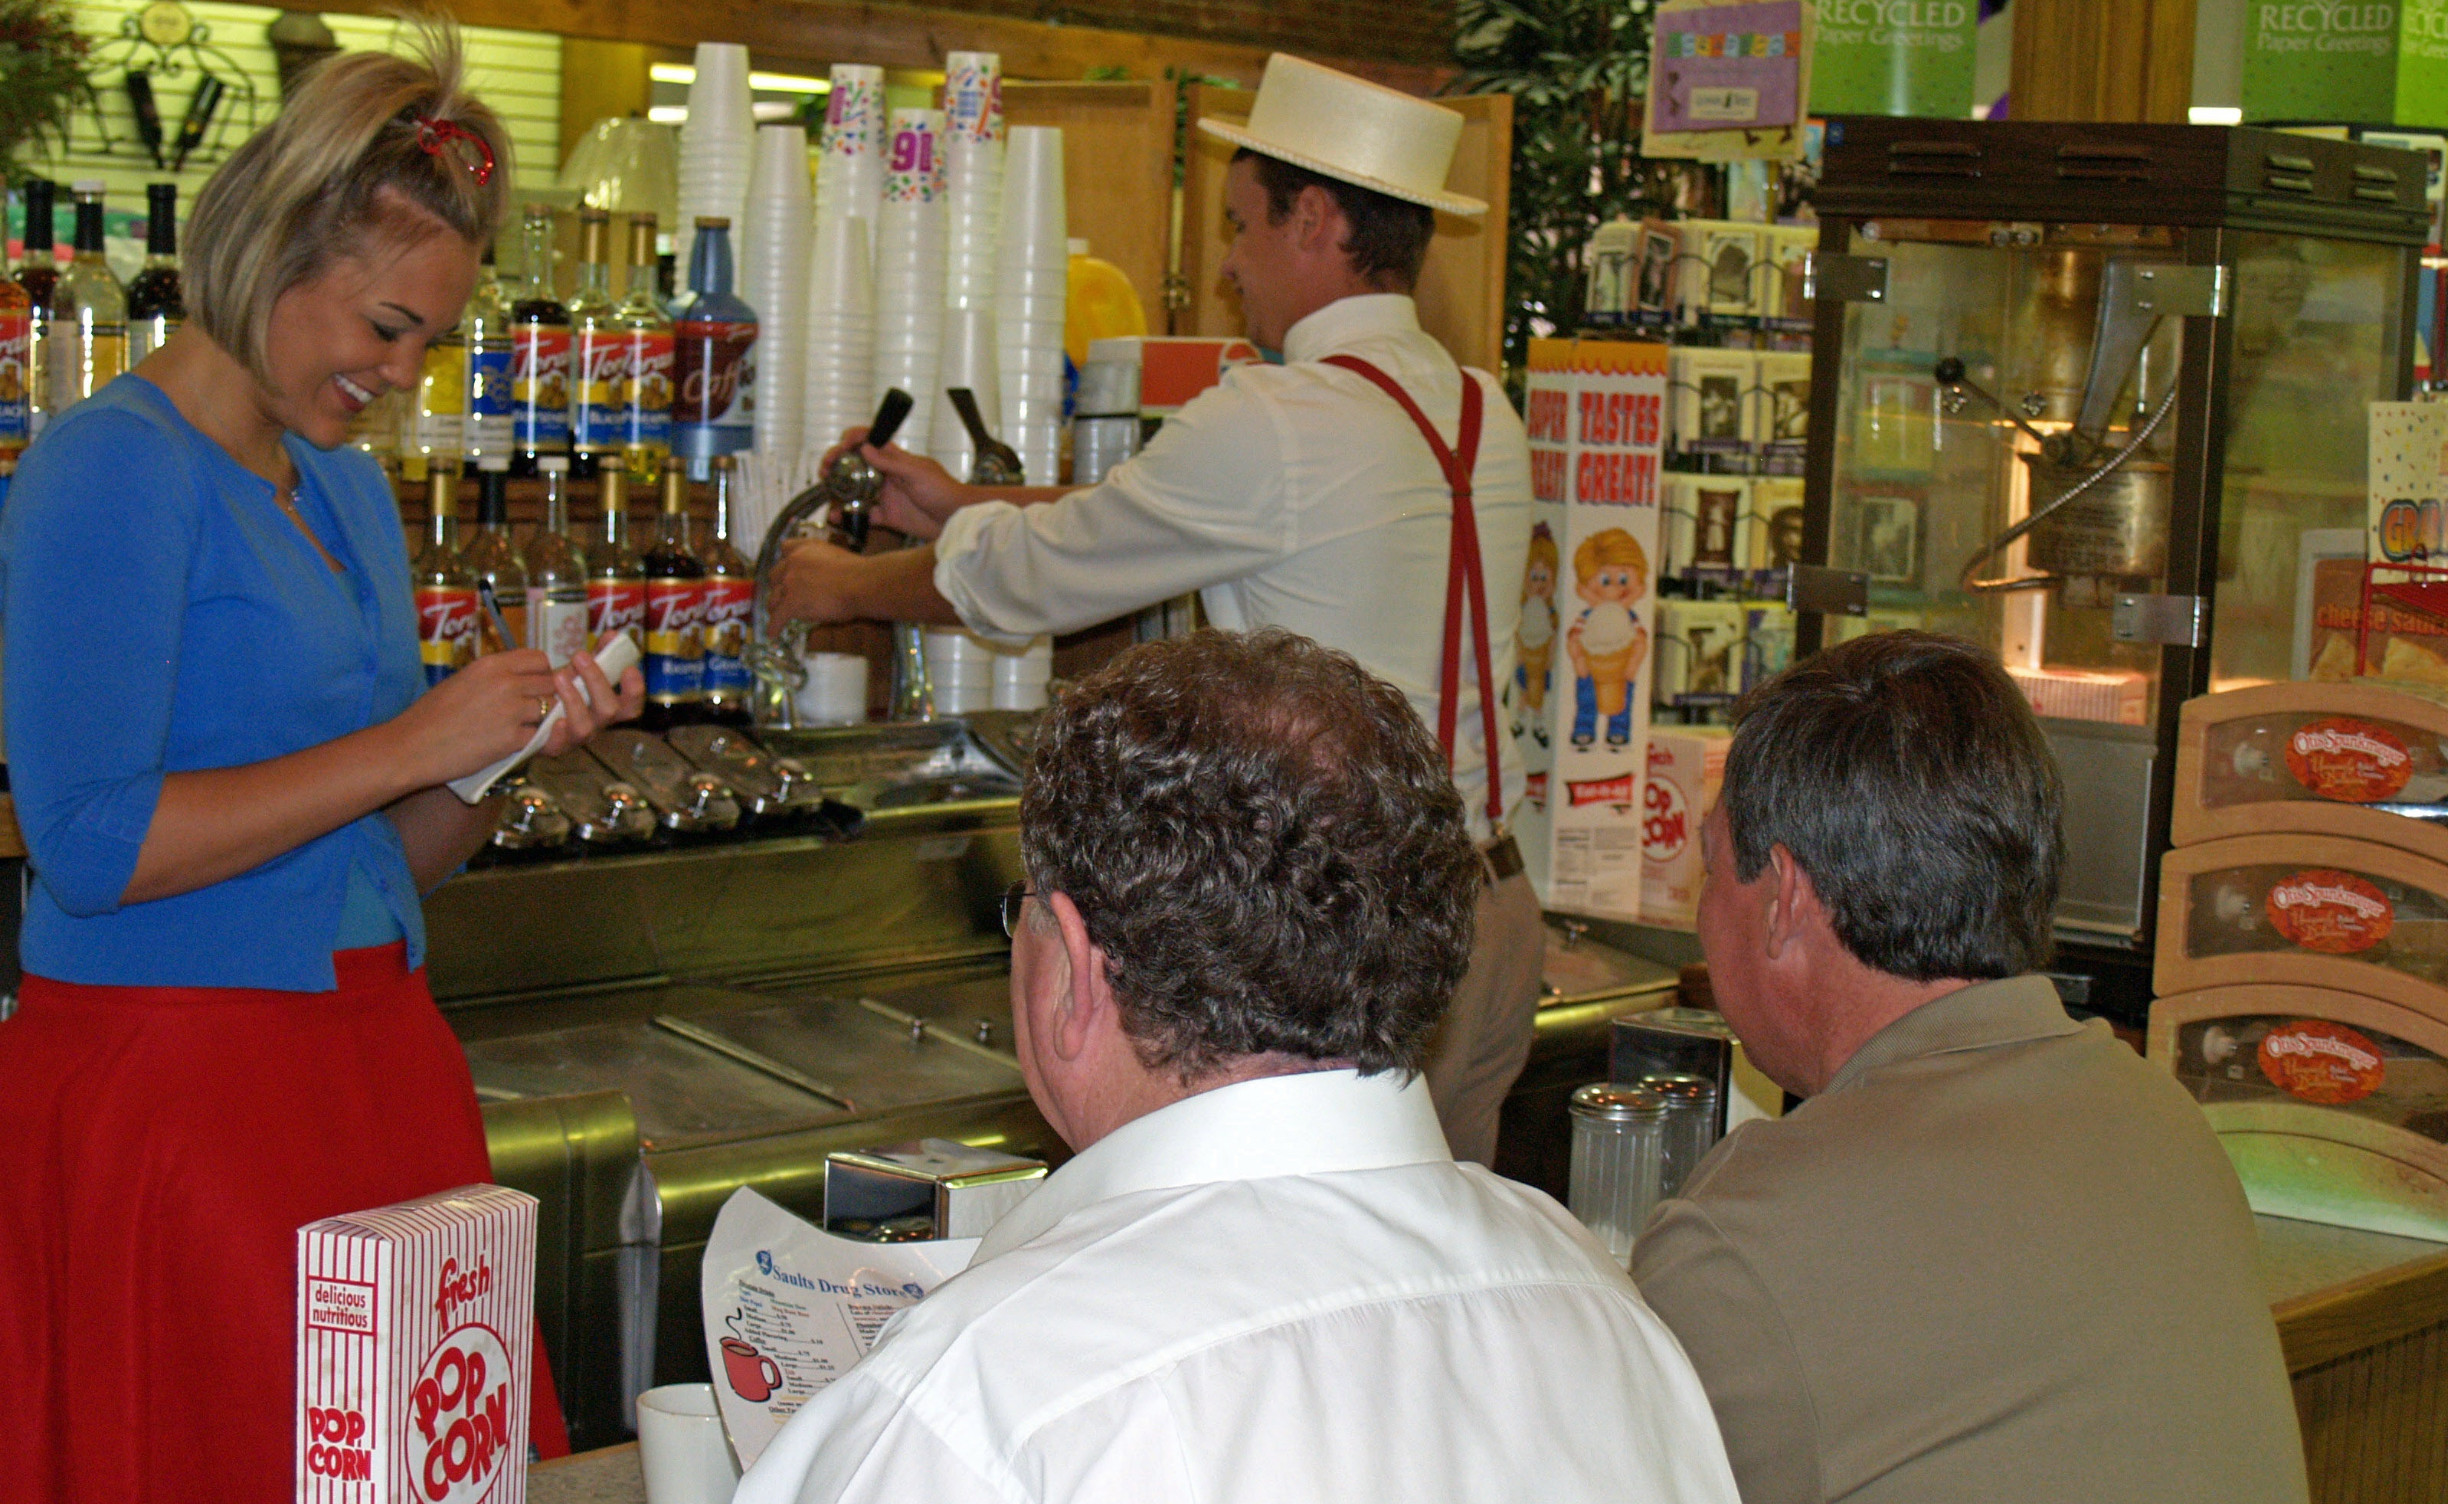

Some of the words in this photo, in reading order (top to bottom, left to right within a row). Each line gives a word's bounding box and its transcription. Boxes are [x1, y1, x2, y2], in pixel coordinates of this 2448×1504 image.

[2260, 2, 2394, 31] RECYCLED
[1579, 391, 1661, 446] TASTES
[1578, 450, 1657, 508] GREAT!
[315, 1285, 366, 1309] delicious
[434, 1253, 491, 1333] fresh
[773, 1265, 815, 1290] Saults
[817, 1278, 862, 1299] Drug
[863, 1283, 908, 1299] Store
[312, 1307, 368, 1329] nutritious
[415, 1346, 487, 1446] POP
[308, 1406, 366, 1447] POP
[423, 1382, 507, 1502] CORN
[308, 1444, 372, 1481] CORN
